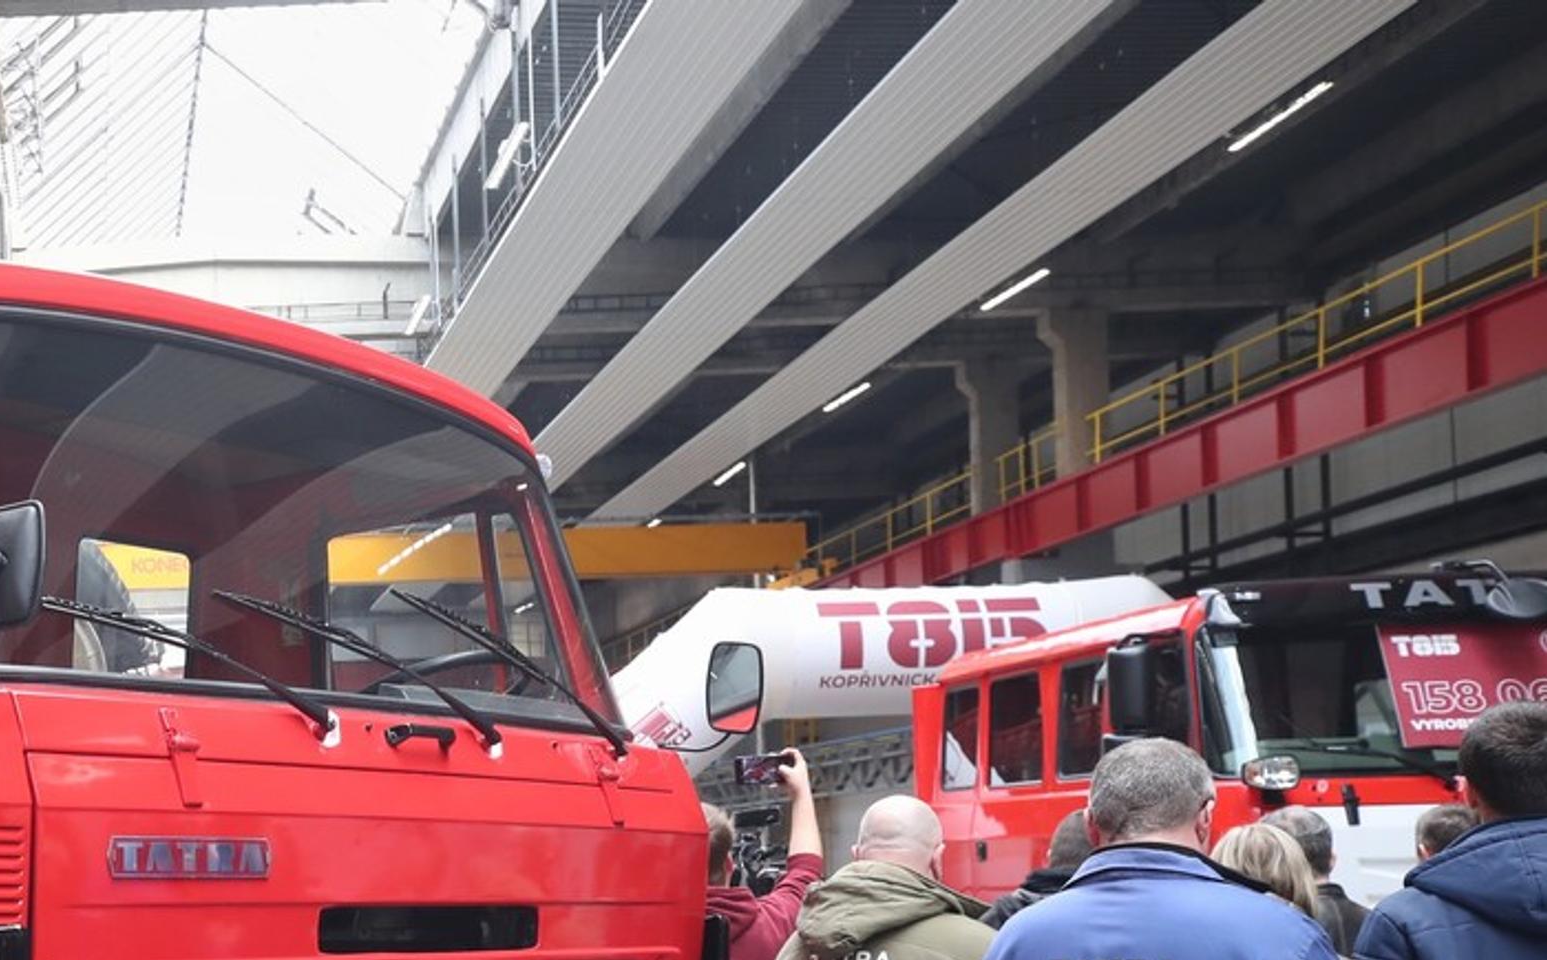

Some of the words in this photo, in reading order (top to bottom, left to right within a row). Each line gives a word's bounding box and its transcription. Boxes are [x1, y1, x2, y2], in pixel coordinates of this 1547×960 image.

[1350, 578, 1495, 609] TAT
[819, 669, 942, 688] KOPŘIVNICK
[1401, 679, 1485, 714] 158
[1410, 717, 1475, 731] VYROB
[117, 841, 266, 873] TATRA
